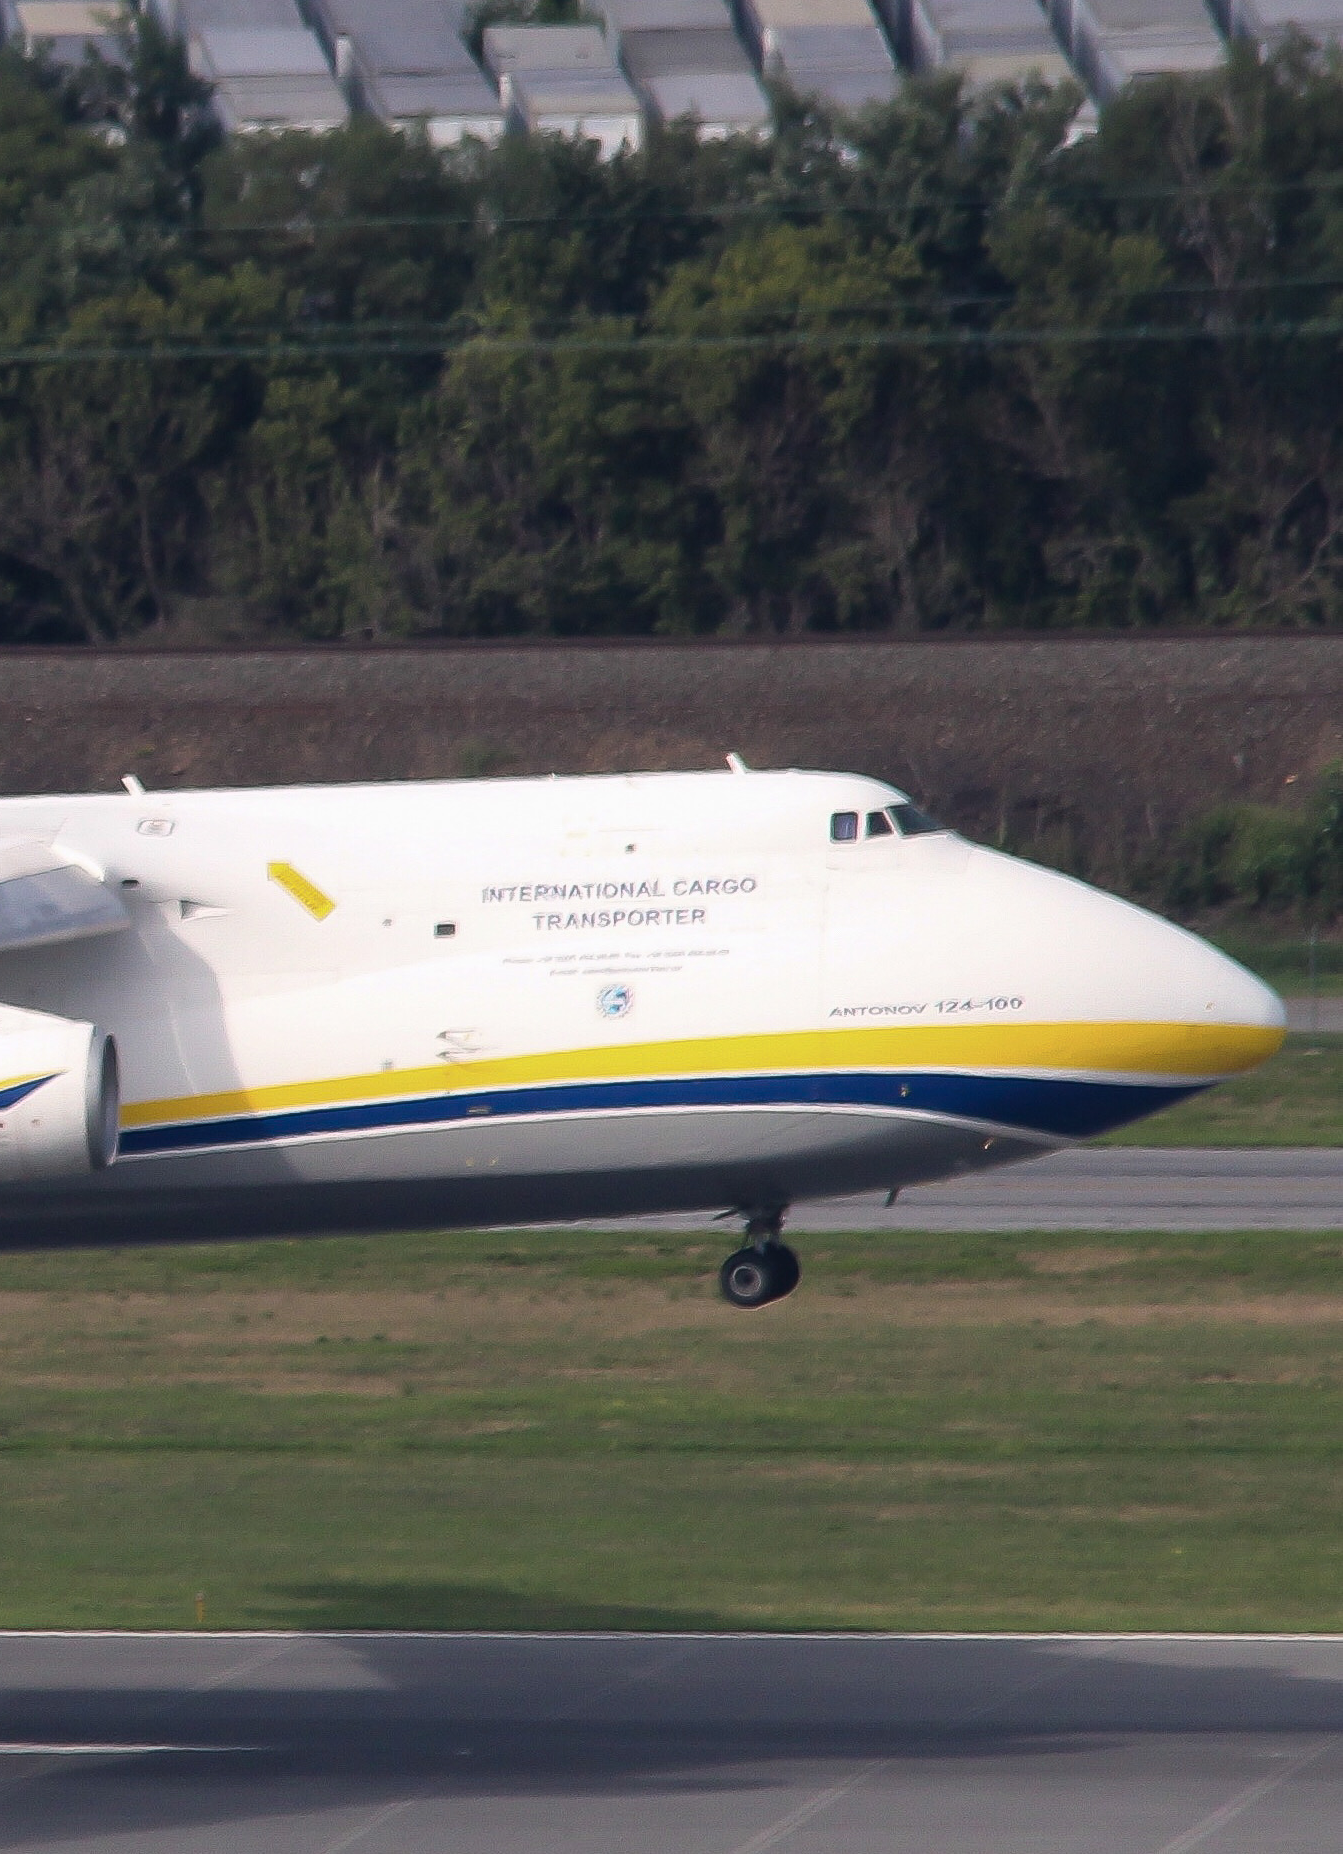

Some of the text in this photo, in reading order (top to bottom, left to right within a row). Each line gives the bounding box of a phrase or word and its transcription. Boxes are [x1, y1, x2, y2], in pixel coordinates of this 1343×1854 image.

[482, 877, 757, 903] INTERNATIONAL CARGO
[532, 908, 707, 931] TRANSPORTER
[829, 997, 1023, 1018] ANTONOV 124-100
